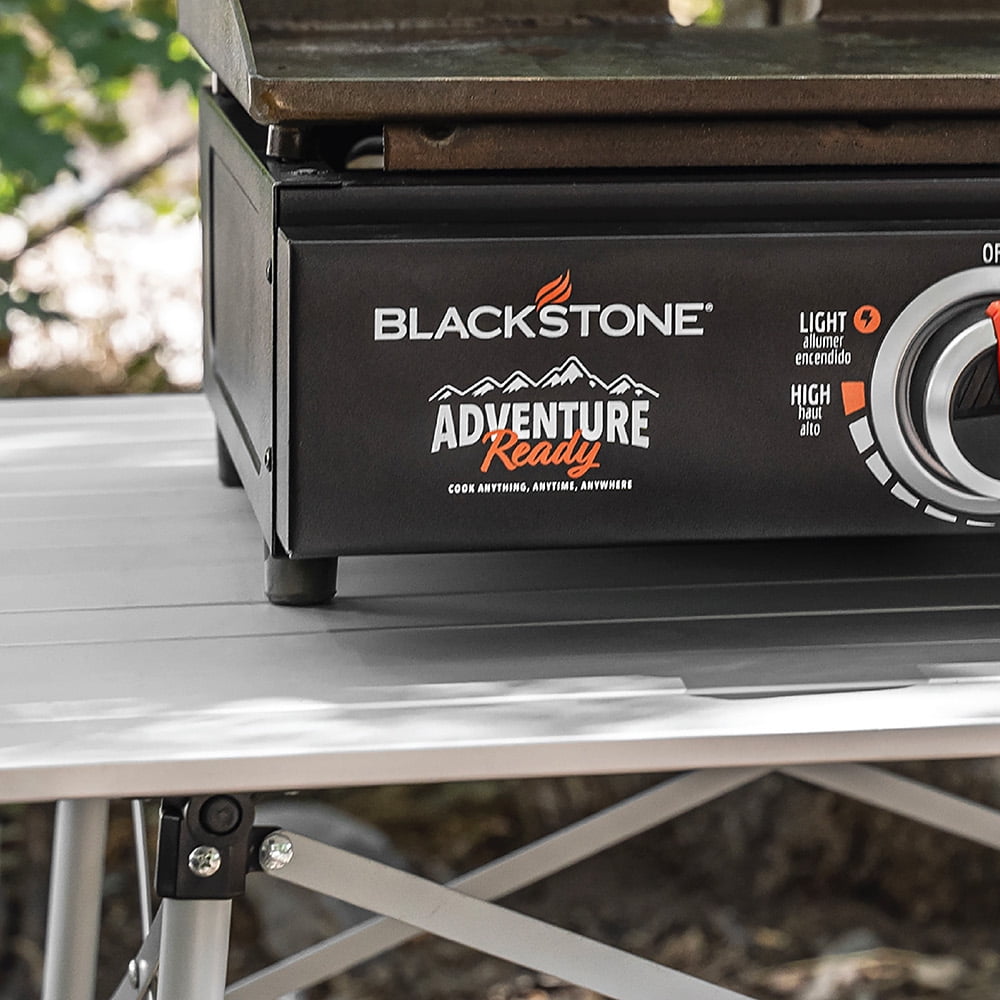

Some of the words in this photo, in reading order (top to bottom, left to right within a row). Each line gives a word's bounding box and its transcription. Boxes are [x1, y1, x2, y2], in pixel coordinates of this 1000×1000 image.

[799, 311, 848, 334] LIGHT
[802, 334, 844, 349] allumer
[794, 348, 851, 366] encendido
[790, 383, 832, 406] HIGH
[798, 405, 822, 420] haut
[431, 400, 650, 454] ADVENTURE
[800, 421, 821, 437] alto
[480, 428, 600, 479] Ready
[448, 482, 475, 494] COOK
[477, 482, 530, 494] ANYTHING,
[532, 480, 578, 493] ANYTIME,
[580, 480, 632, 491] ANYWHERE
